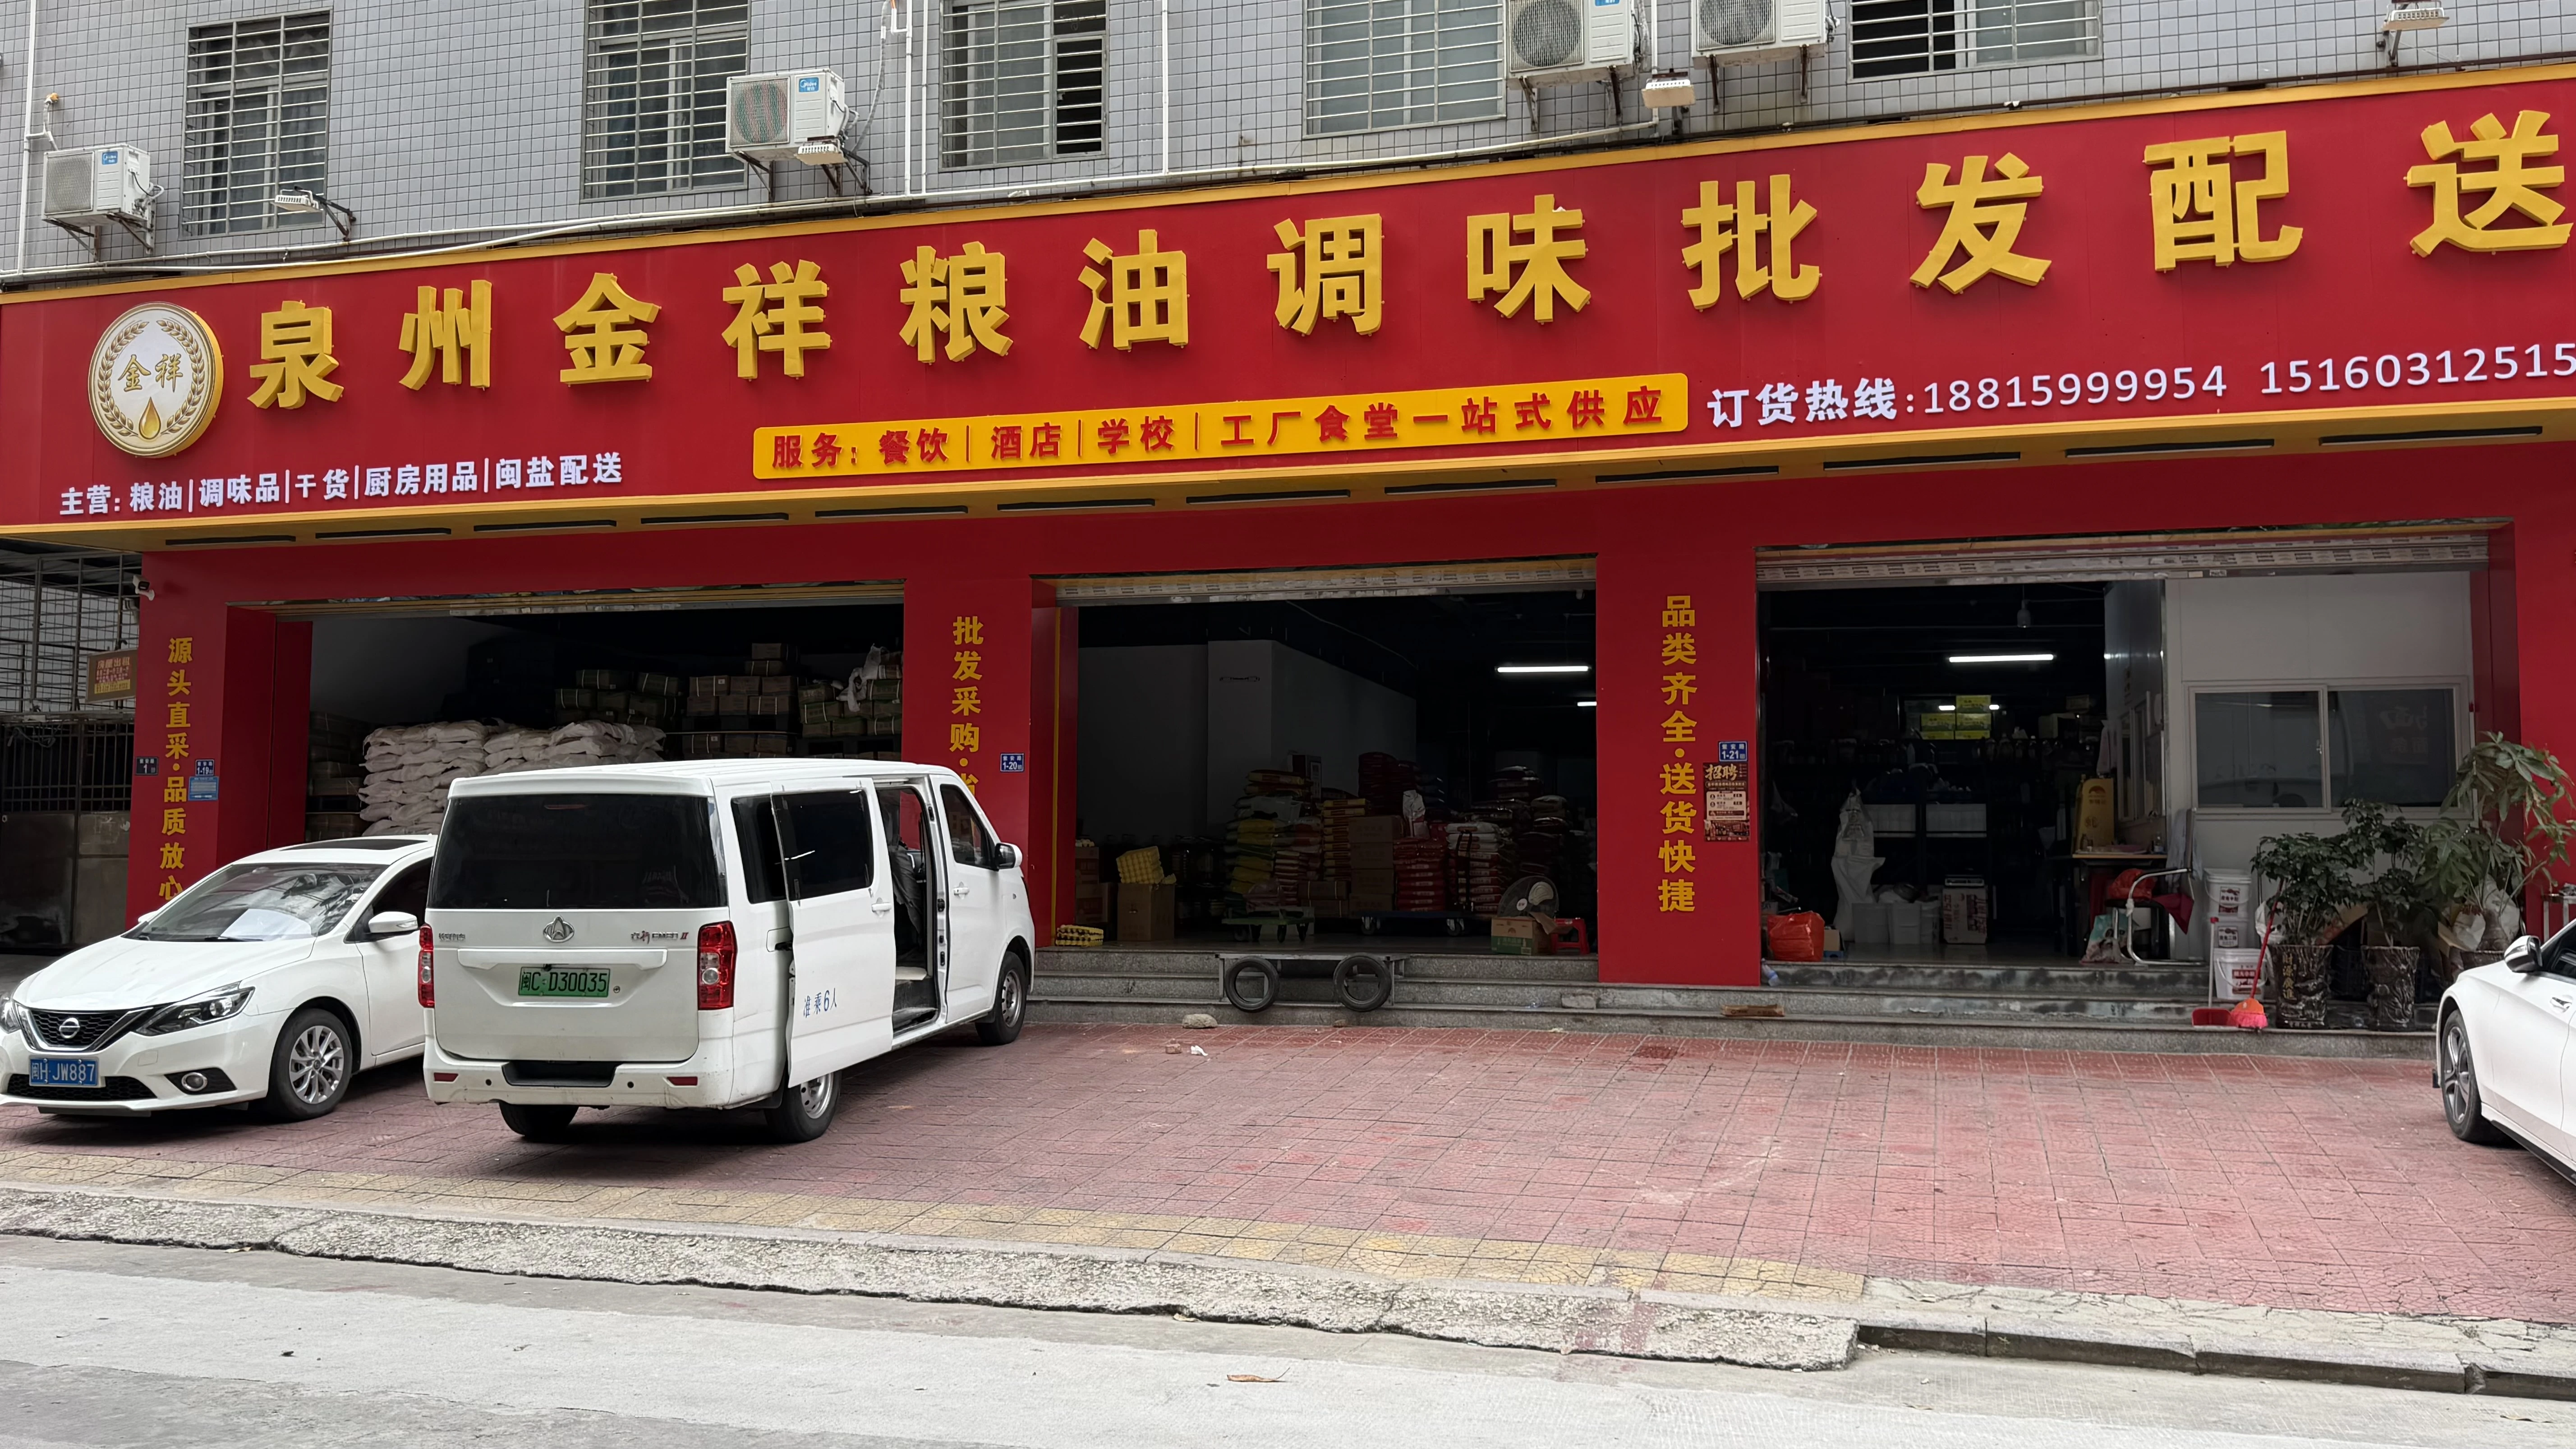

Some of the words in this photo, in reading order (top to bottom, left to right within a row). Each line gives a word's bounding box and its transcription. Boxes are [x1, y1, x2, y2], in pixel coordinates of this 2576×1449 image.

[247, 110, 2574, 409] 泉州金祥粮油调味批发配送
[118, 353, 183, 393] 金祥
[2260, 343, 2576, 395] 15160312515
[197, 767, 213, 775] 1-19
[1705, 763, 1738, 781] 招聘
